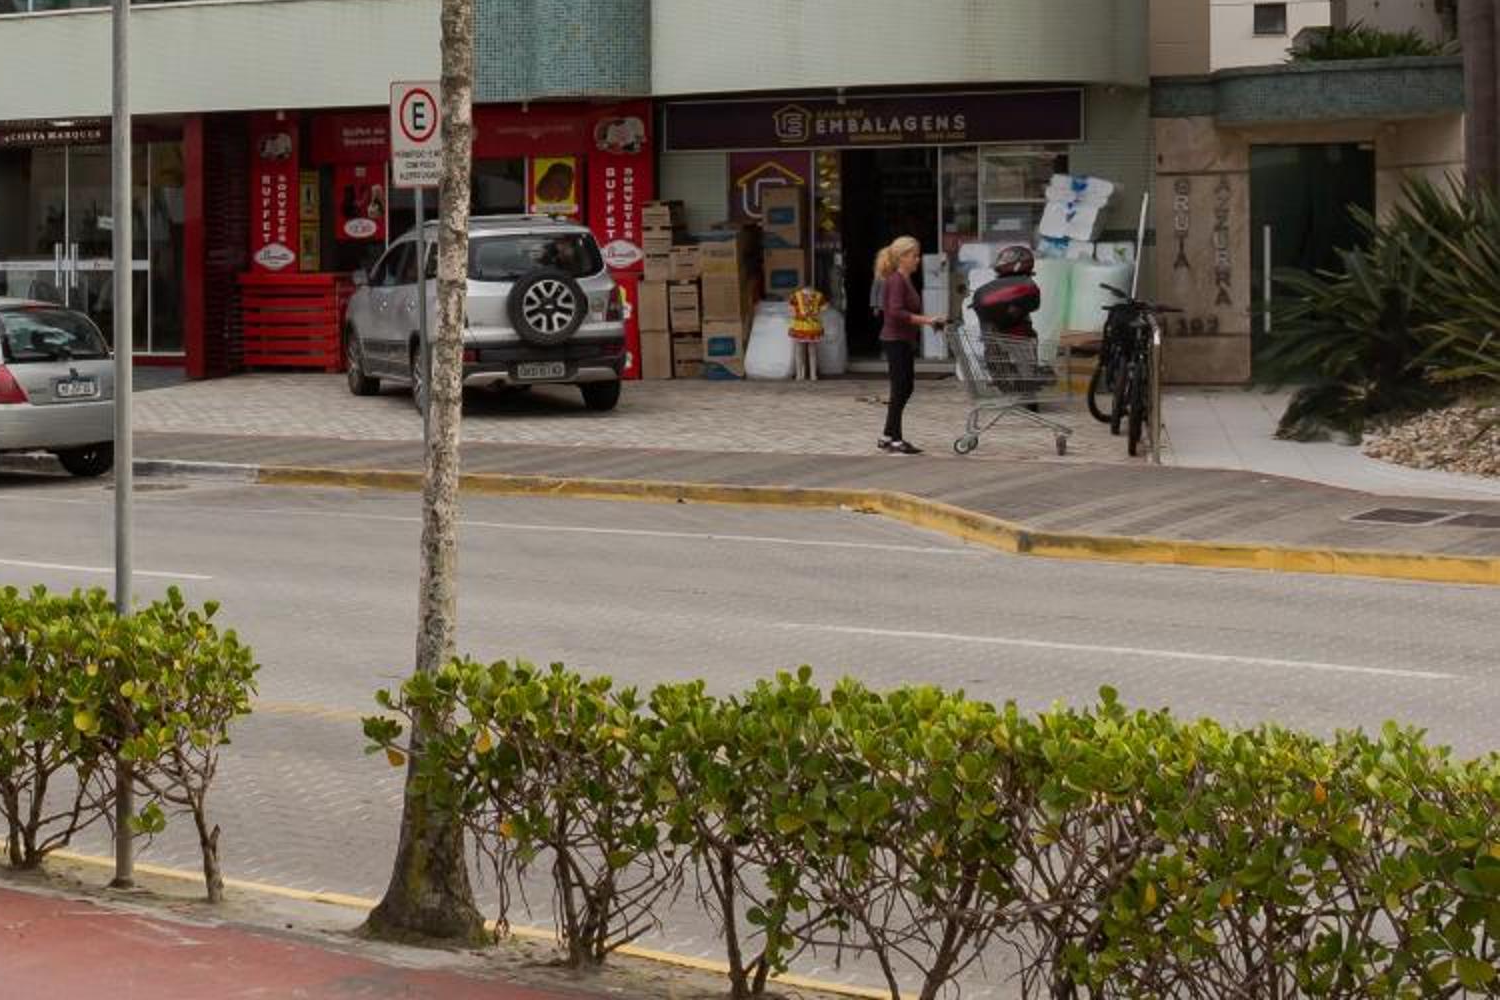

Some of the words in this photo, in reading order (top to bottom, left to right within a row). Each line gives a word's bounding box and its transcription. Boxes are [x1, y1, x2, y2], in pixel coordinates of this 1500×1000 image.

[11, 131, 45, 141] COSTA
[412, 102, 426, 130] E
[815, 105, 966, 133] EMBALAGENS
[261, 175, 271, 243] BUFFET
[605, 167, 616, 239] BUFFET
[623, 167, 634, 239] SORVETES
